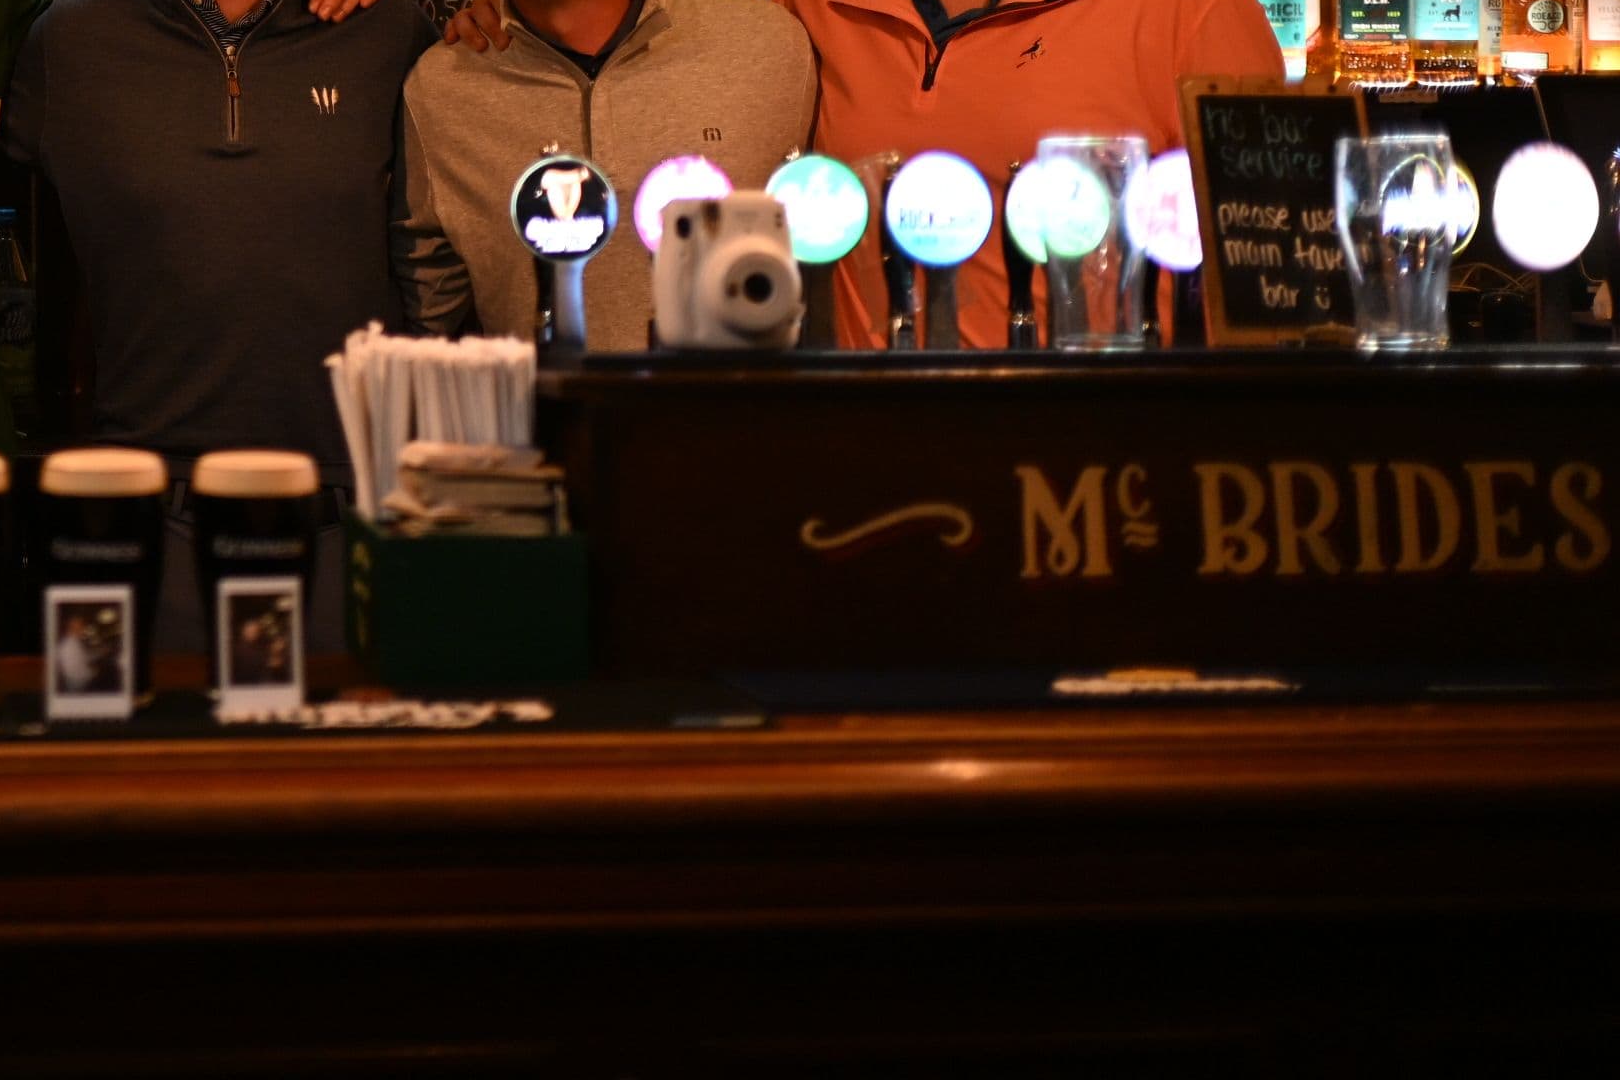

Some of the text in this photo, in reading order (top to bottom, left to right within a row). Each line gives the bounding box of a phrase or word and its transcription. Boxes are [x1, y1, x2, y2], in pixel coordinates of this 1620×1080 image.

[1219, 144, 1325, 180] service
[1217, 198, 1291, 234] please
[1259, 274, 1300, 310] bar
[1193, 461, 1613, 577] BRIDES
